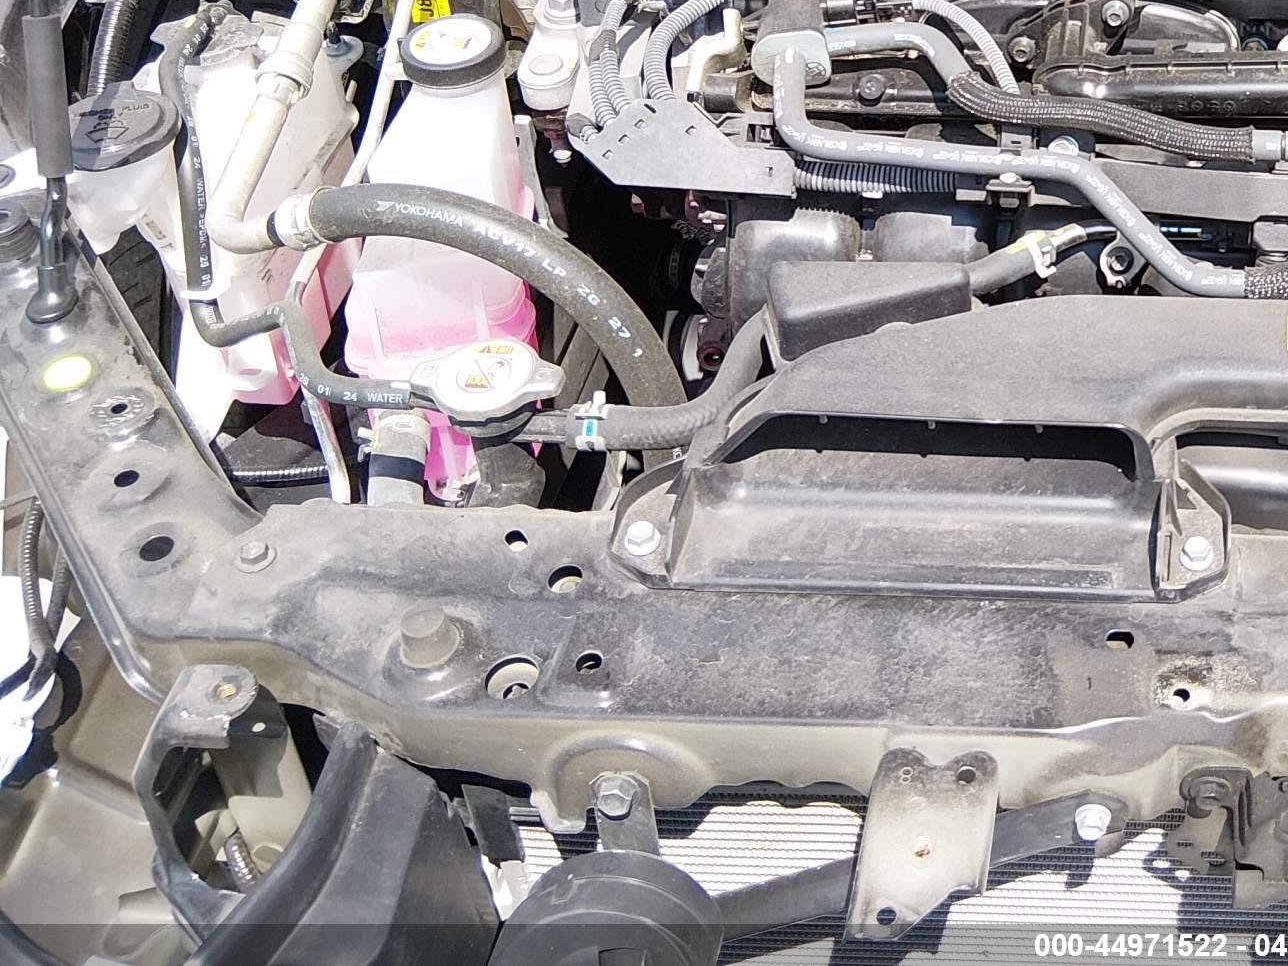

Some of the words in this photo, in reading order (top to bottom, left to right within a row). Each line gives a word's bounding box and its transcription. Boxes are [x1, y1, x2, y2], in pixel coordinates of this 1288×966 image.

[394, 202, 464, 228] YOKOHAMA
[541, 257, 568, 277] LP
[343, 390, 359, 402] 24
[367, 392, 404, 404] WATER
